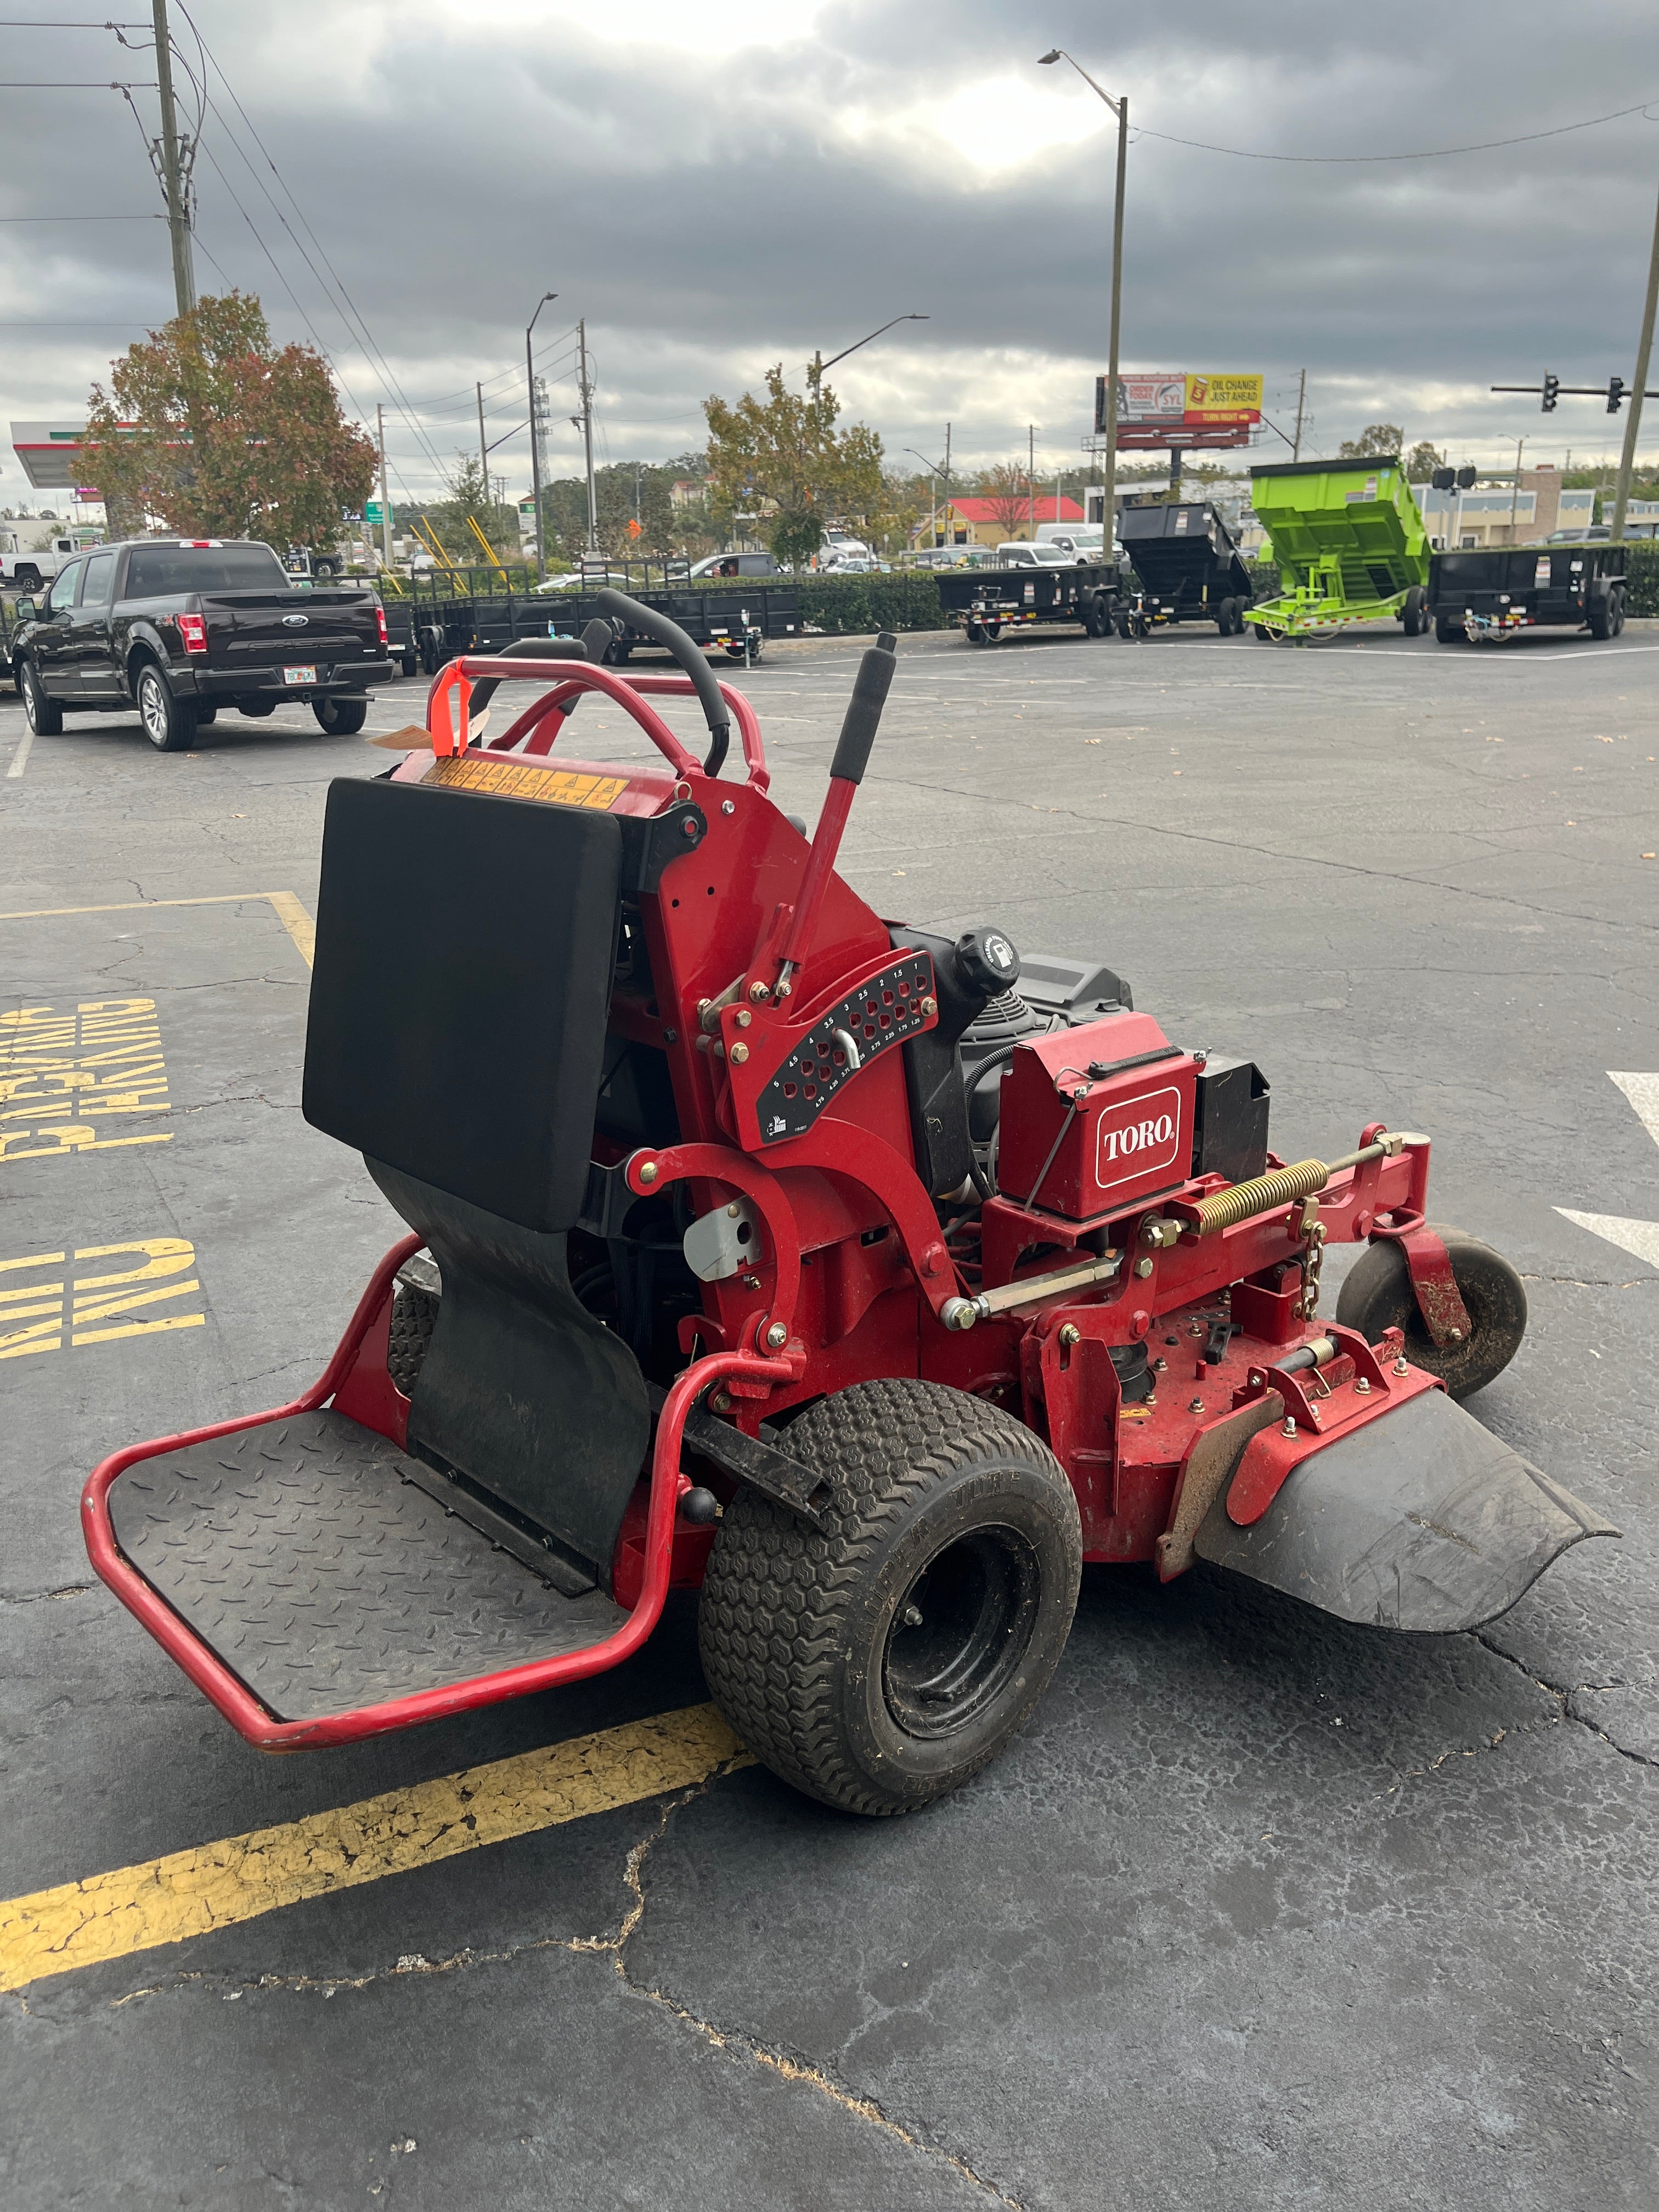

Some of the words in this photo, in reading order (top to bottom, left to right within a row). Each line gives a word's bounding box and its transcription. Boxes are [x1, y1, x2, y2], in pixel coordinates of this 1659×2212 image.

[1163, 395, 1183, 405] SYL
[1210, 392, 1232, 402] JUST
[1233, 392, 1257, 402] AHEAD
[1212, 381, 1224, 391] OIL
[1225, 380, 1258, 391] CHANGE
[1203, 413, 1220, 421] TURN
[1221, 413, 1238, 421] RIGHT
[788, 1056, 798, 1068] 4.5
[824, 1017, 834, 1029] 3.5
[858, 990, 868, 1001] 2.5
[893, 969, 902, 979] 1.5
[0, 998, 175, 1162] PARKING
[815, 1096, 825, 1108] 4.75
[829, 1079, 839, 1091] 4.25
[871, 1041, 881, 1051] 2.75
[884, 1031, 895, 1041] 2.25
[898, 1024, 907, 1032] 1.75
[911, 1017, 921, 1026] 1.25
[1104, 1115, 1173, 1161] TORO
[0, 1238, 205, 1359] NO
[947, 1470, 1022, 1510] TURF
